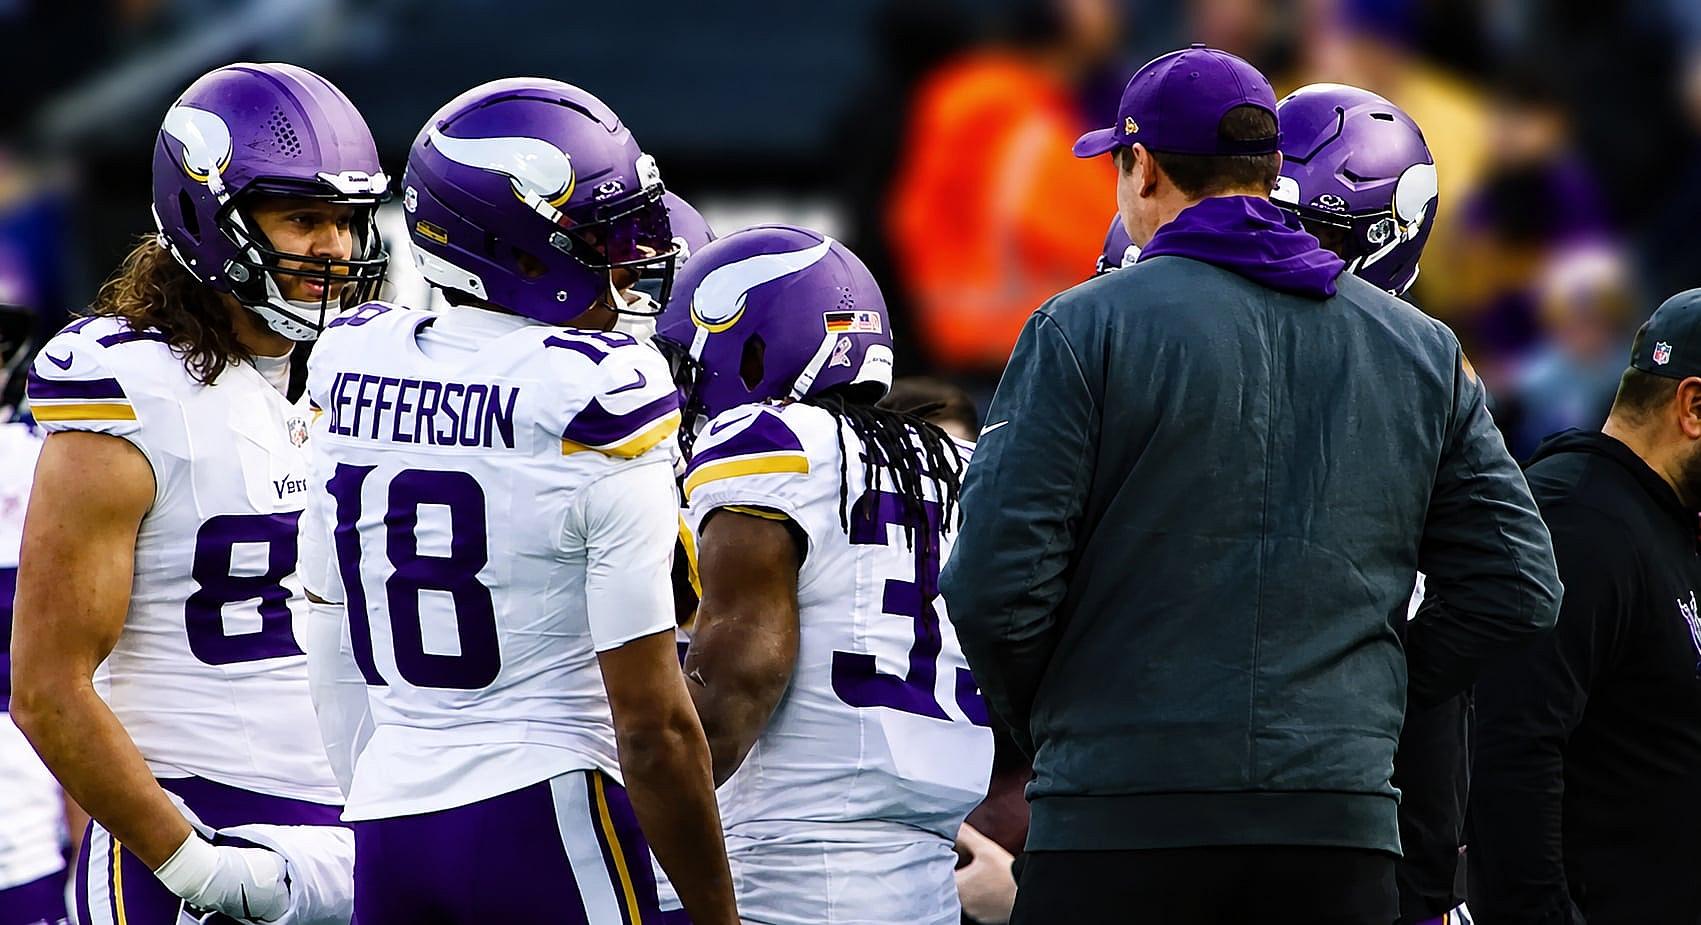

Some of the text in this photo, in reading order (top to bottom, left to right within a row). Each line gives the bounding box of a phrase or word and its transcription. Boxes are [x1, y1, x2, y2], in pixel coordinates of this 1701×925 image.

[328, 372, 521, 449] JEFFERSON
[325, 462, 502, 690] 18
[831, 488, 993, 728] 3
